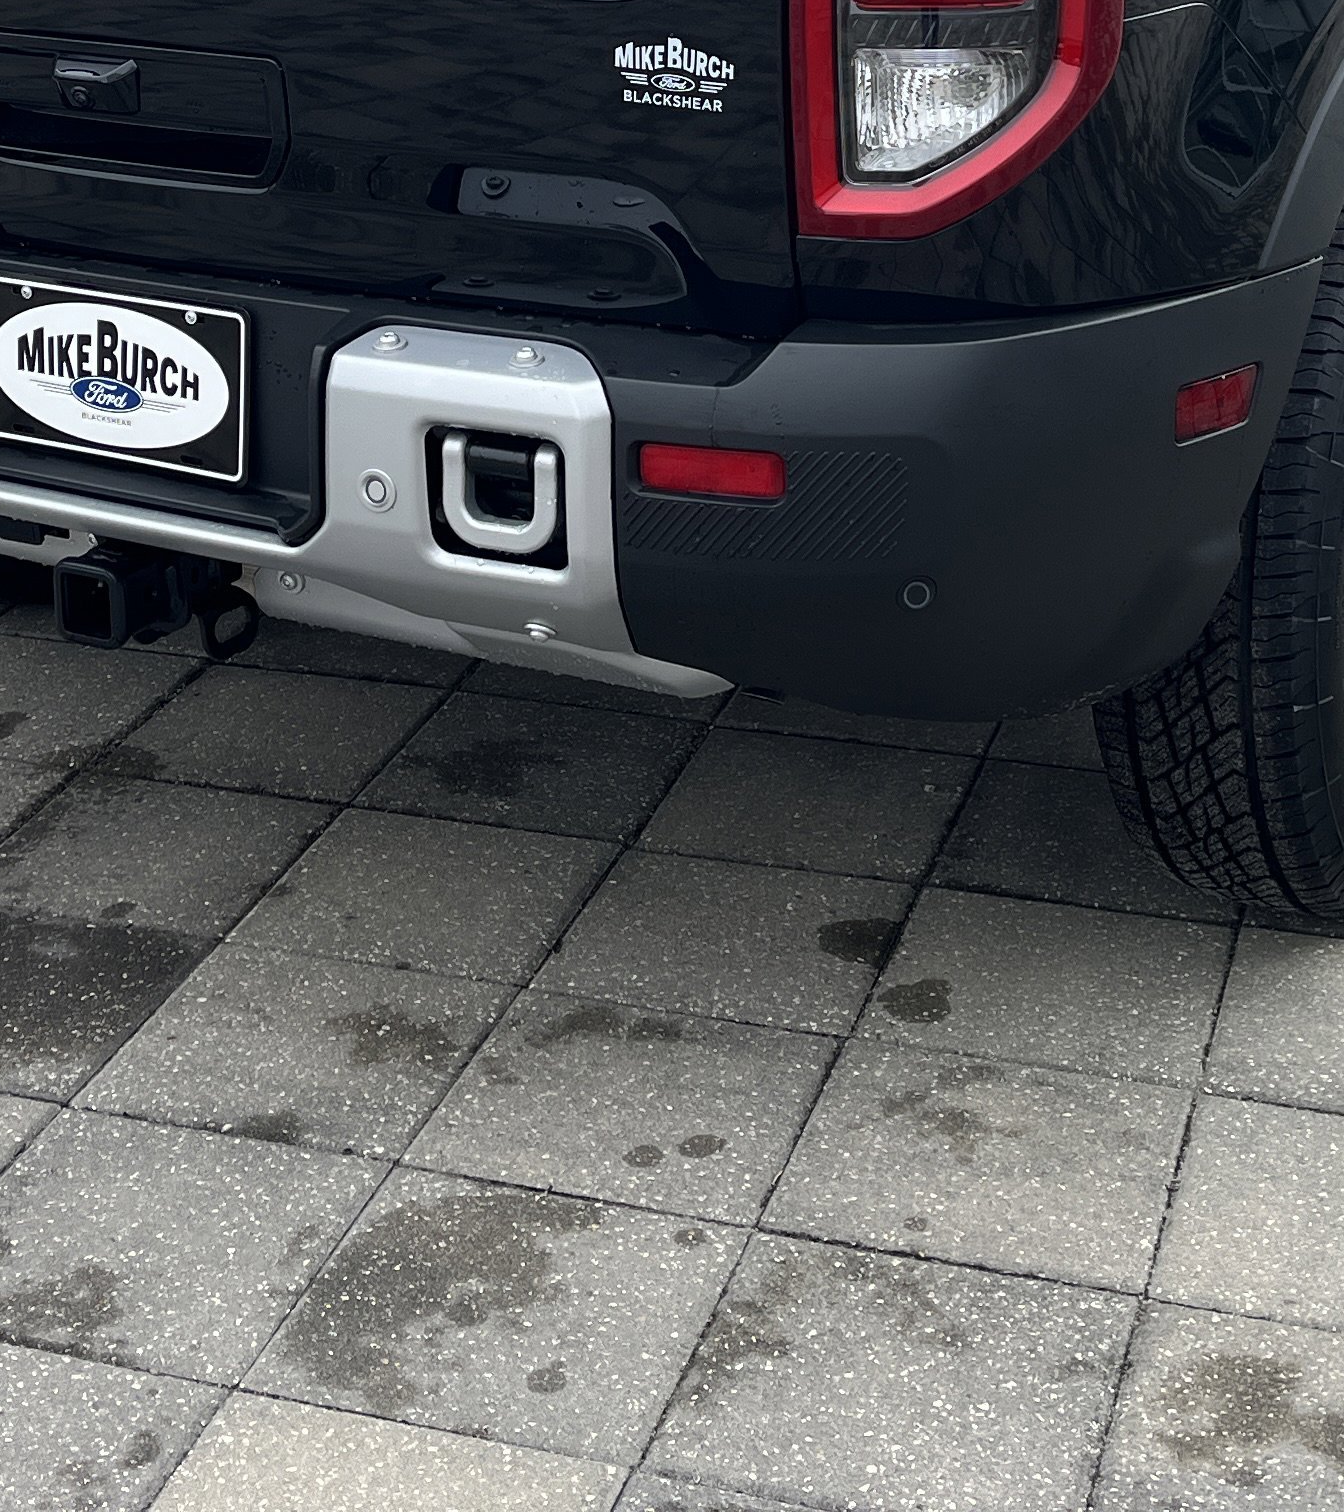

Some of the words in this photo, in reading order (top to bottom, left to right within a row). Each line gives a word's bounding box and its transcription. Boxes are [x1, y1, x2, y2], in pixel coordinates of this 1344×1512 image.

[658, 75, 687, 90] Ford
[623, 89, 723, 113] BLACKSHEAR
[84, 381, 128, 410] Ford
[81, 411, 132, 427] BLACKSHEAR
